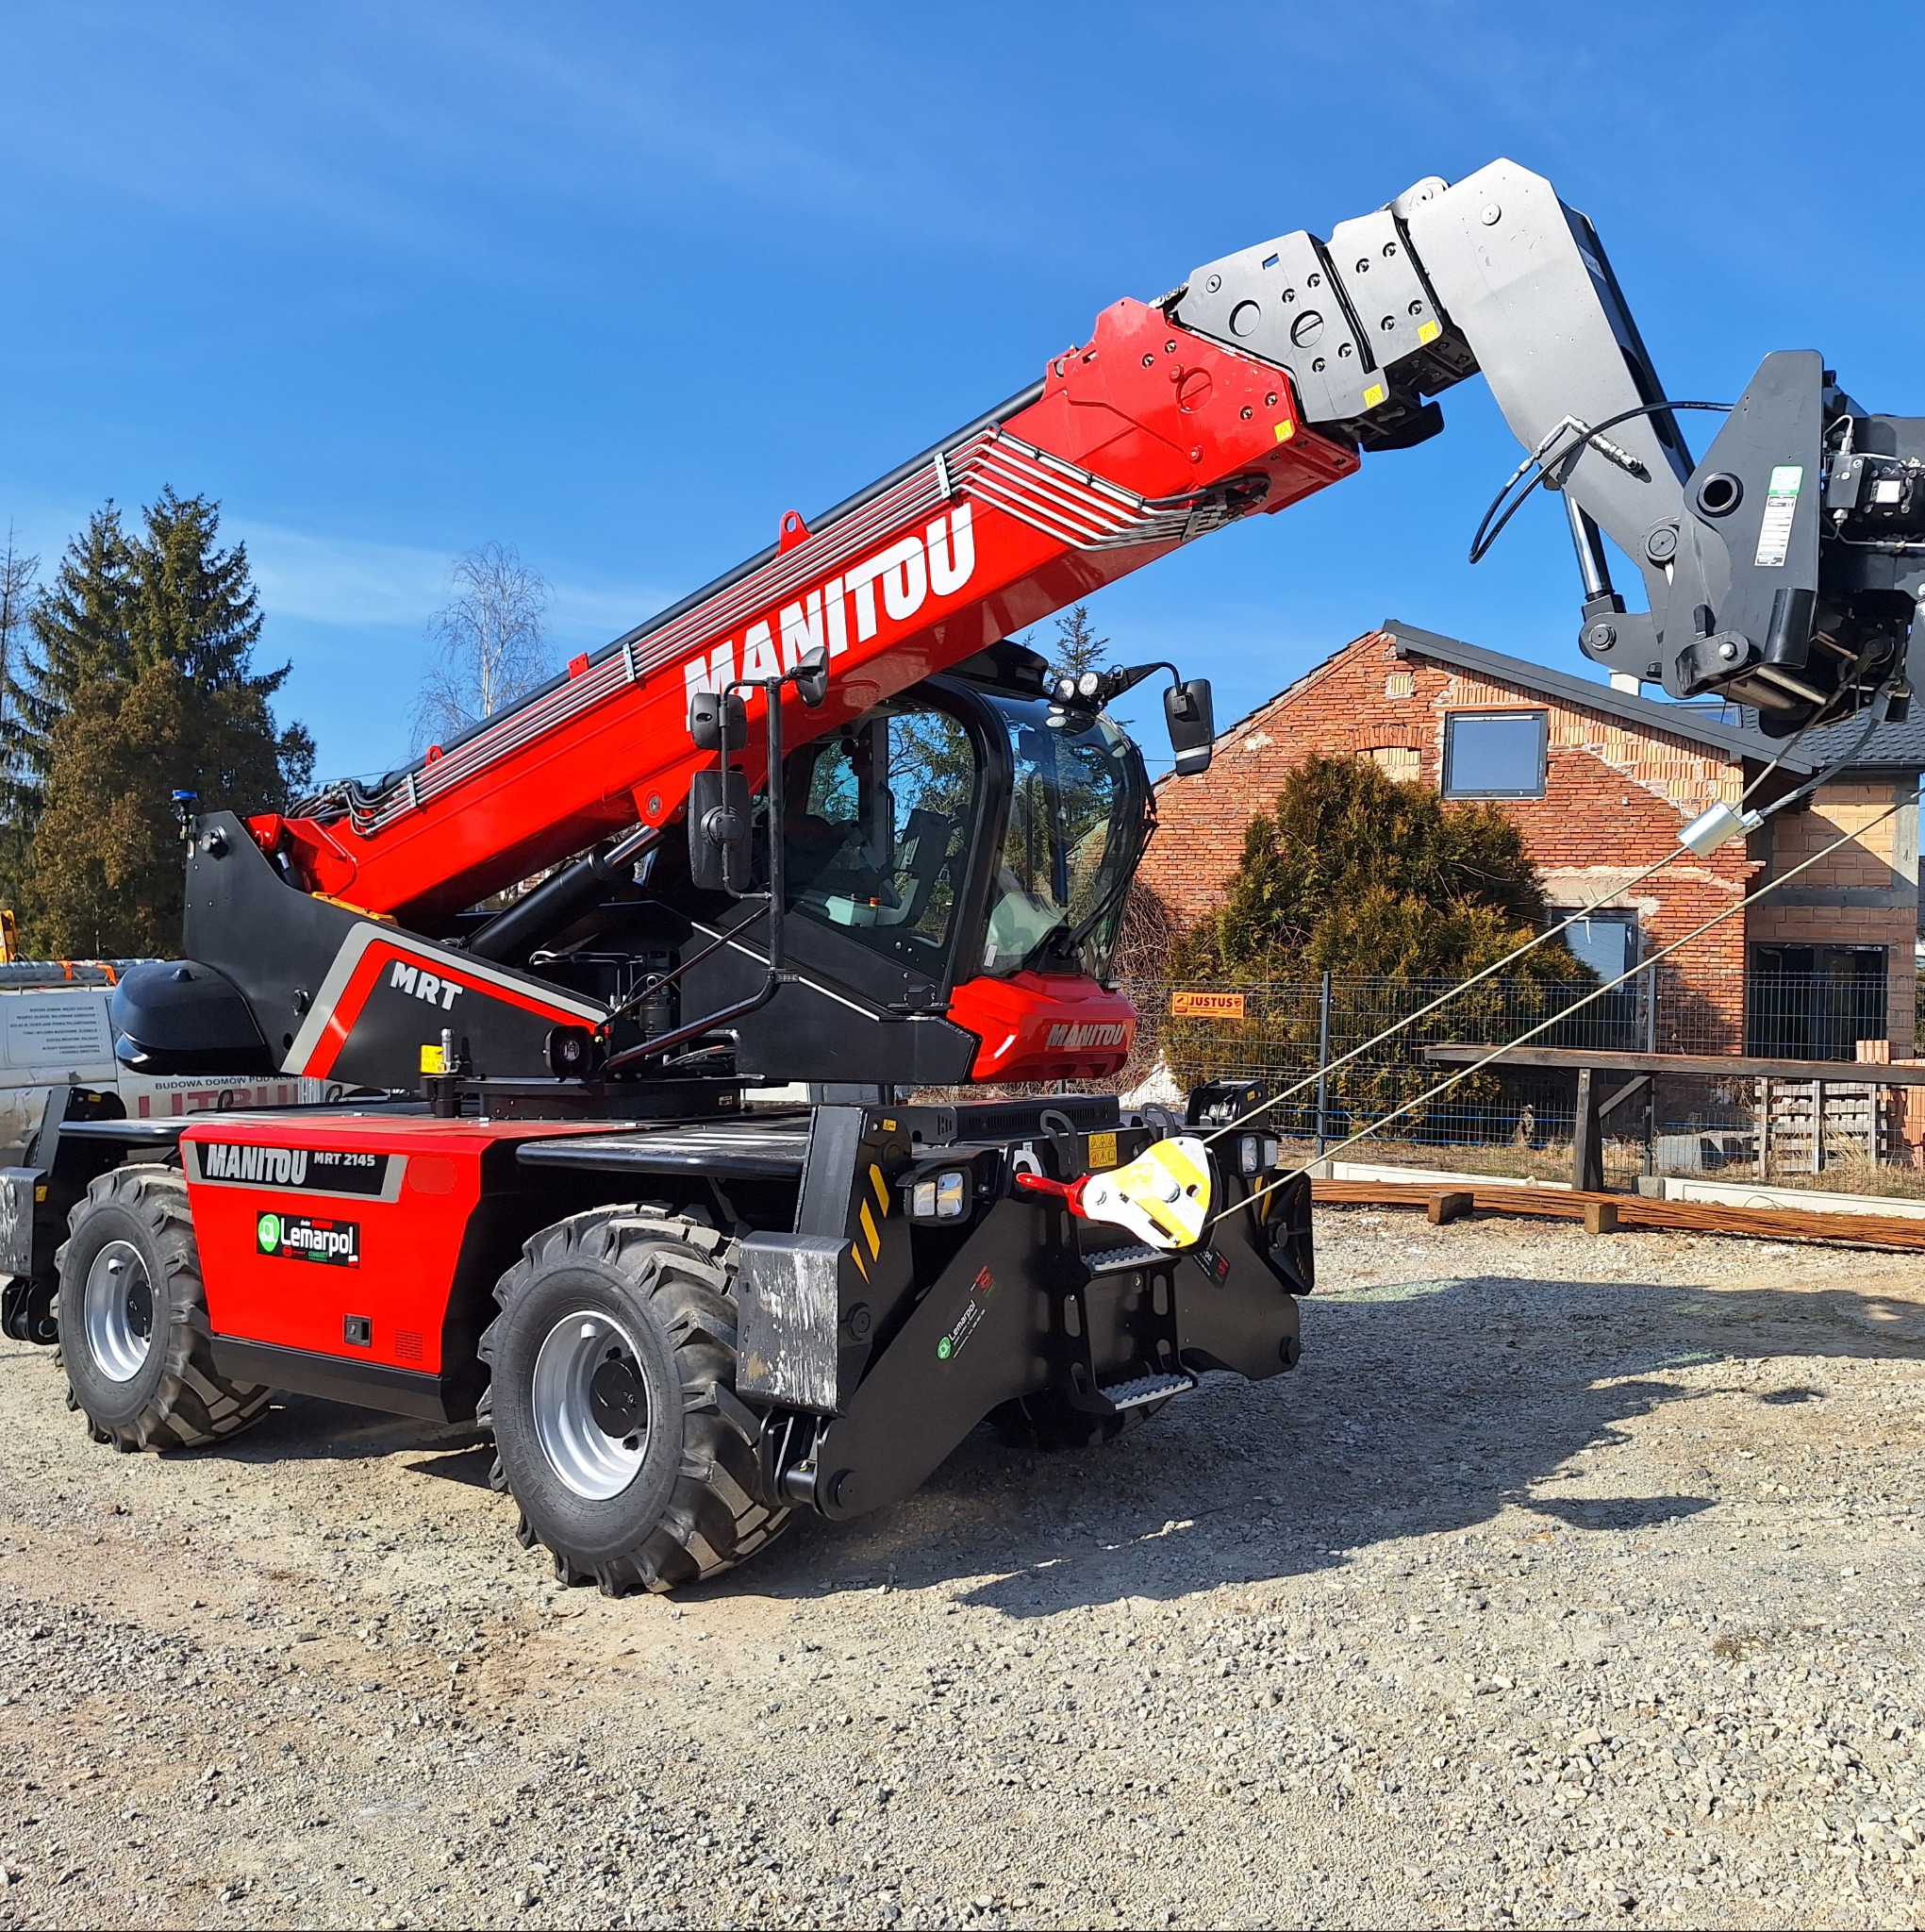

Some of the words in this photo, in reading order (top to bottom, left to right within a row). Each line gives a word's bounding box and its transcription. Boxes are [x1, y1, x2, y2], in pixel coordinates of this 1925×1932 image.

[684, 502, 975, 732] MANITOU
[390, 960, 464, 1011] MRT
[1189, 996, 1233, 1008] JUSTUS
[1046, 1024, 1128, 1047] MANITOU
[155, 1080, 203, 1091] BUDOWA
[206, 1143, 308, 1185] MANITOU
[313, 1152, 342, 1165] MRT
[343, 1154, 375, 1167] 2145
[280, 1217, 354, 1258] Lemarpol
[948, 1299, 976, 1341] Lemarpol
